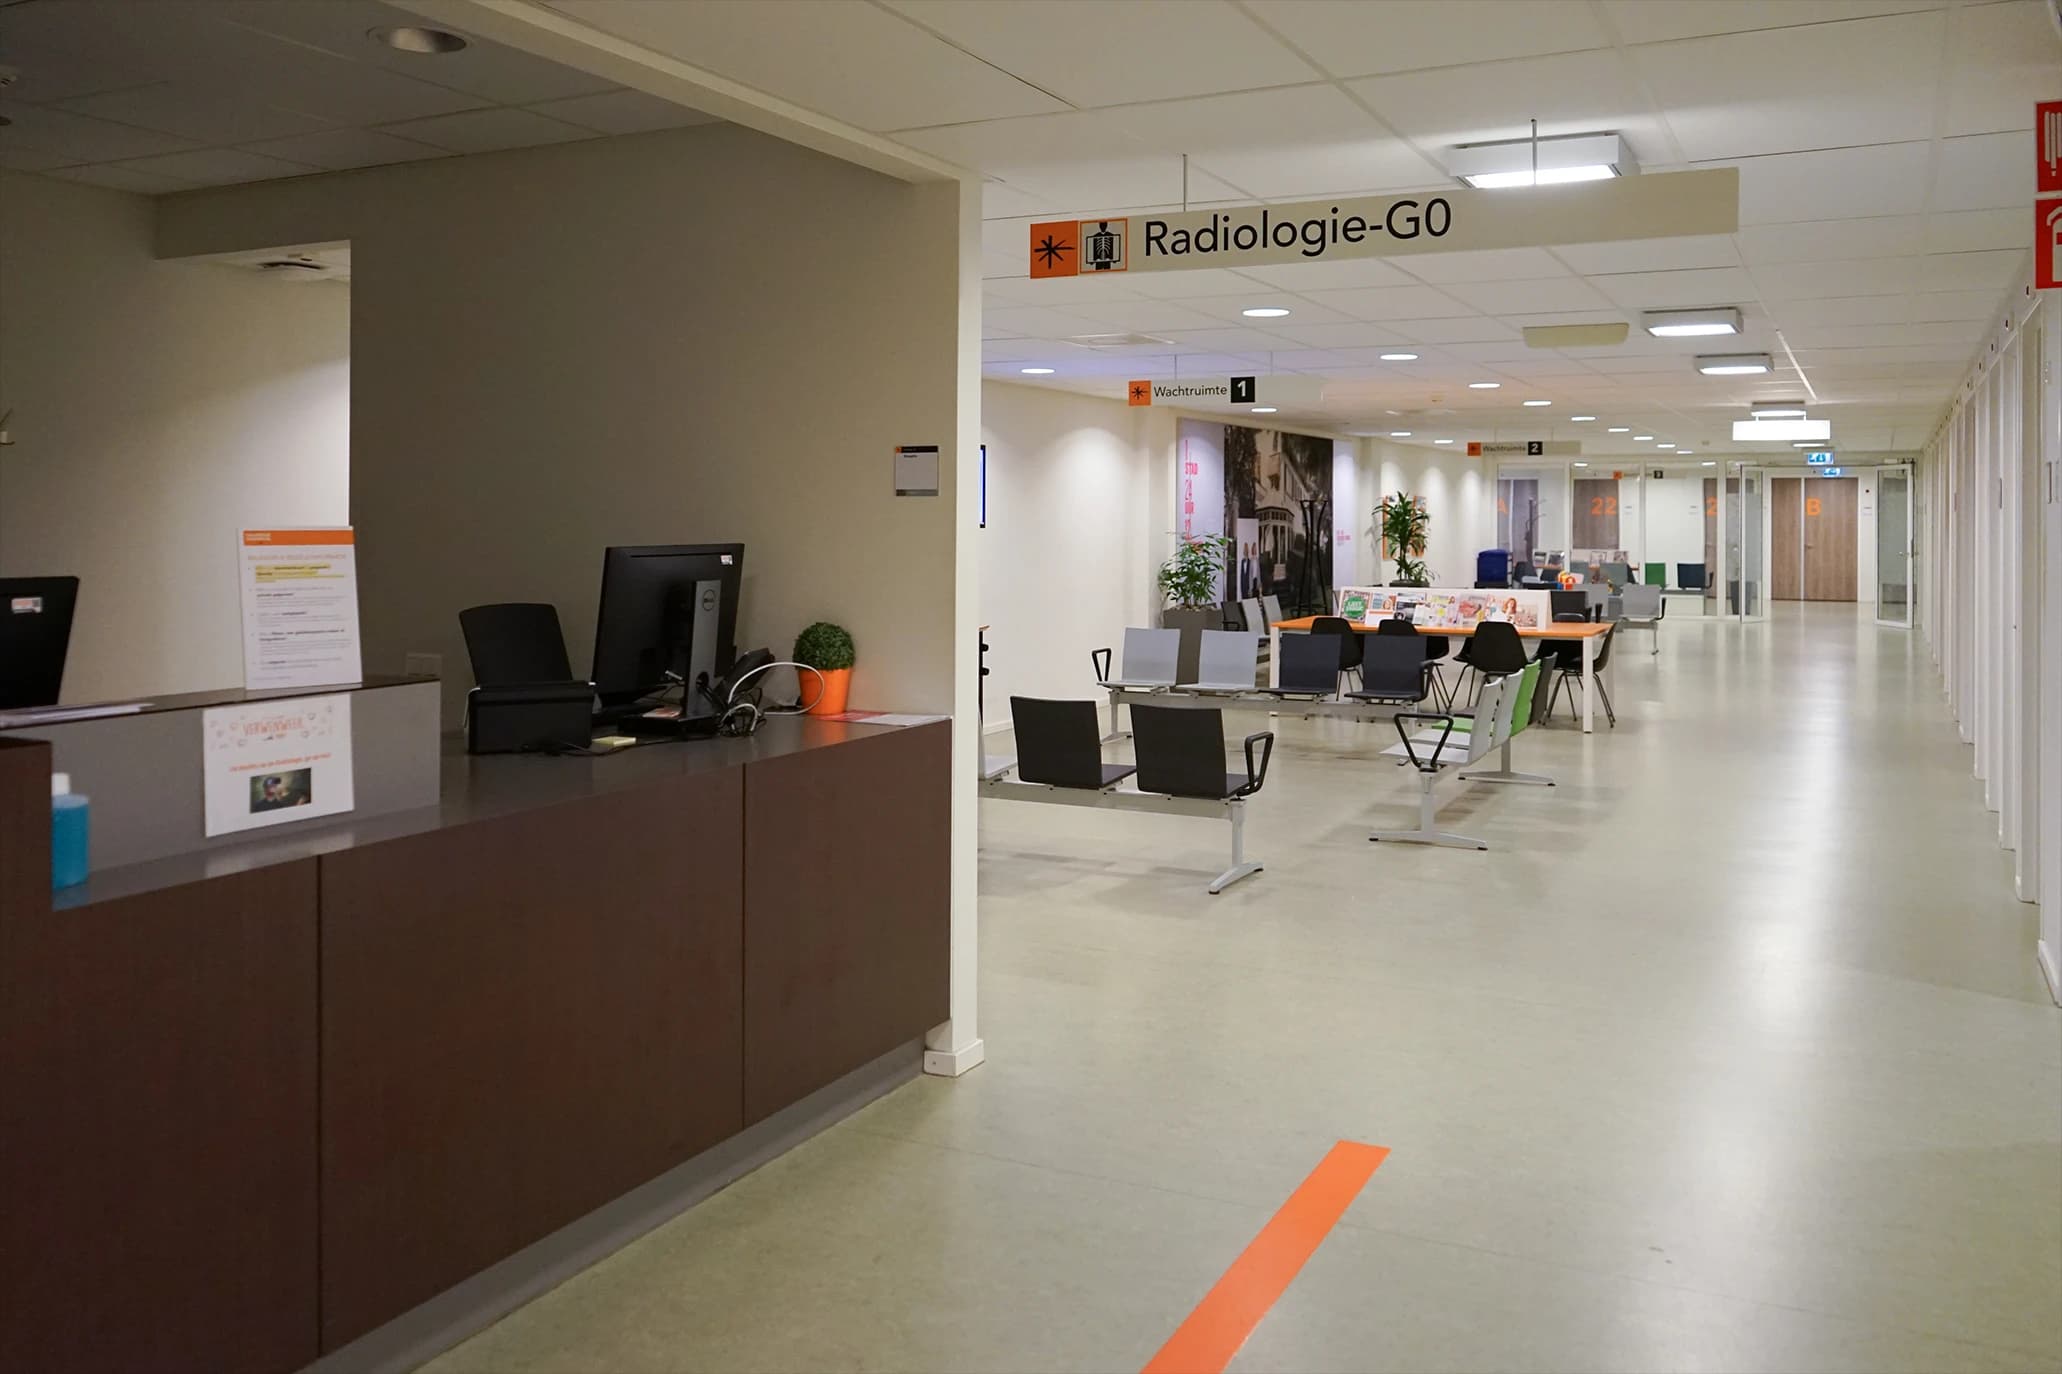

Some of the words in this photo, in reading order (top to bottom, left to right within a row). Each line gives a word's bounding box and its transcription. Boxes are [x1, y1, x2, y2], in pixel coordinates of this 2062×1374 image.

[1145, 197, 1452, 257] Radiologie-G0
[1153, 384, 1227, 398] Wachtruimte
[1236, 380, 1248, 398] 1
[1530, 442, 1539, 453] 2
[1591, 496, 1617, 516] 22
[1806, 498, 1822, 516] B
